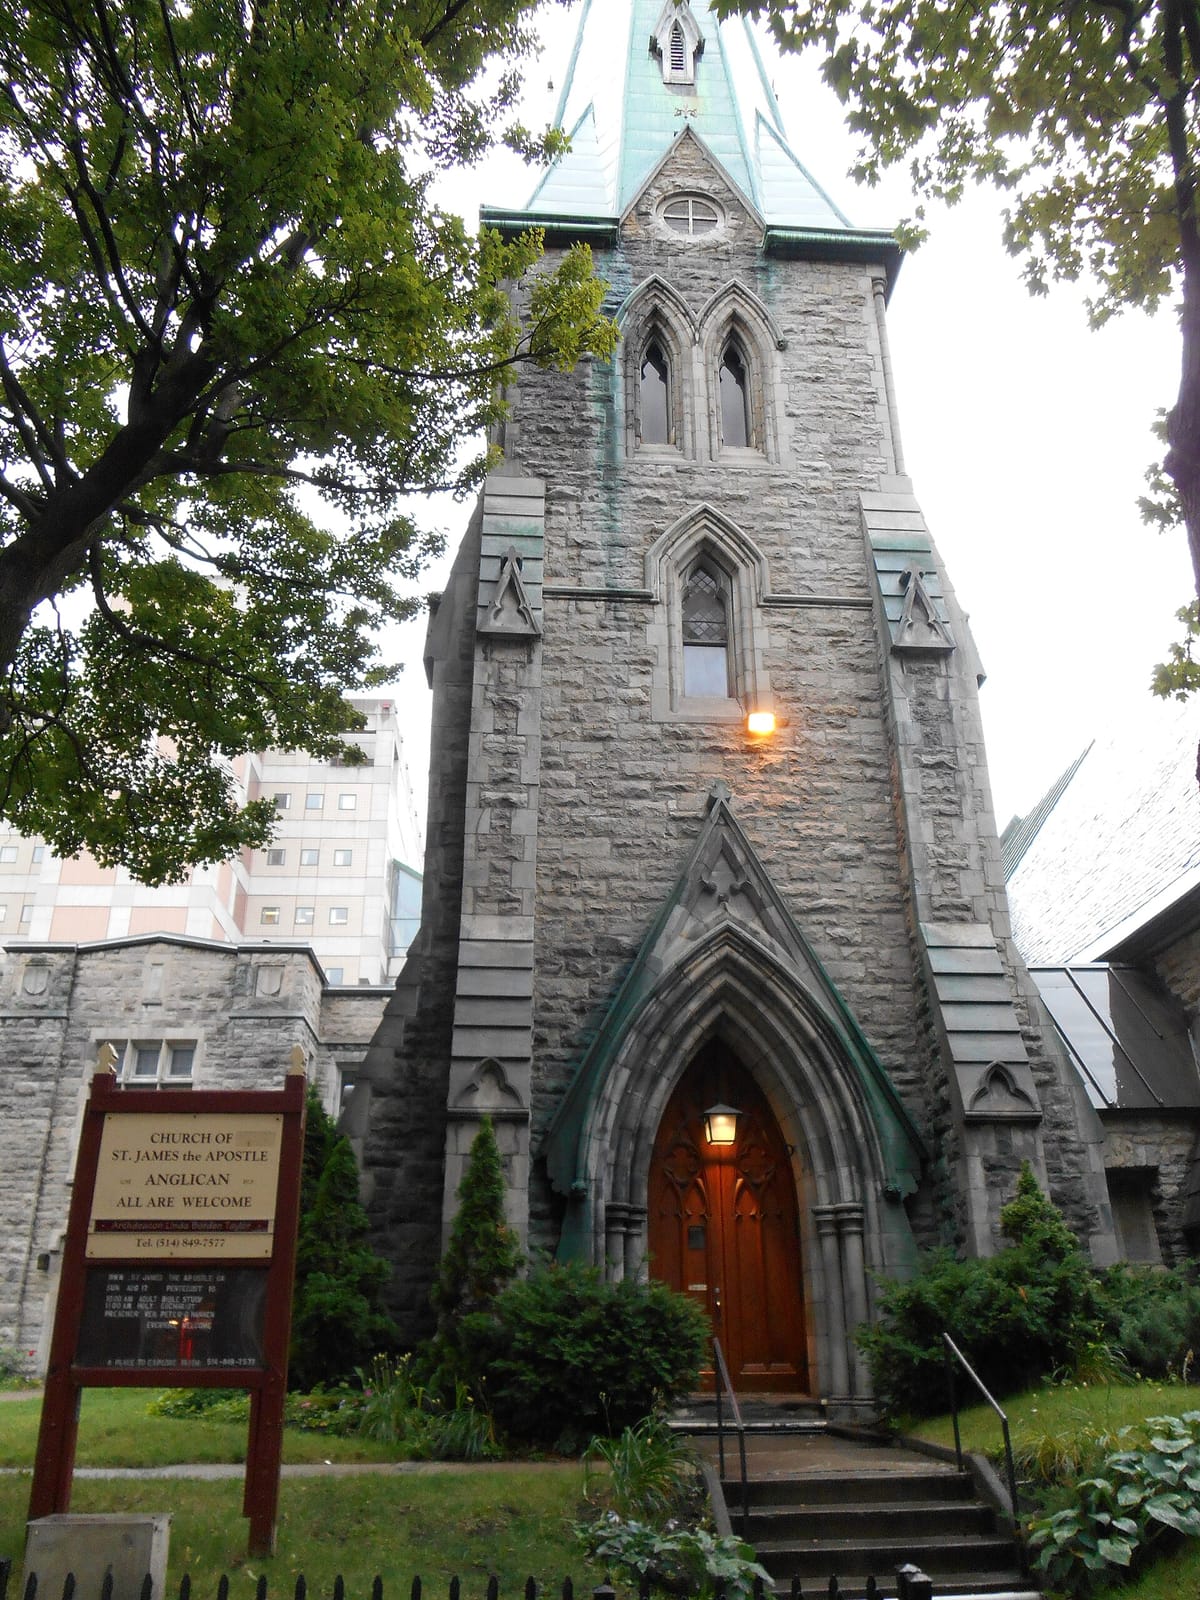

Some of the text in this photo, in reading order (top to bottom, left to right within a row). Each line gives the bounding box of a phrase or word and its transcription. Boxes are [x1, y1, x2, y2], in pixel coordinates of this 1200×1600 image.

[150, 1132, 234, 1144] CHURCH OF
[112, 1150, 268, 1163] ST. JAMES the APOSTLE
[144, 1174, 230, 1186] ANGLICAN
[116, 1196, 252, 1208] ALL ARE WELCOME
[136, 1238, 226, 1248] Tel. (514) 849-7577
